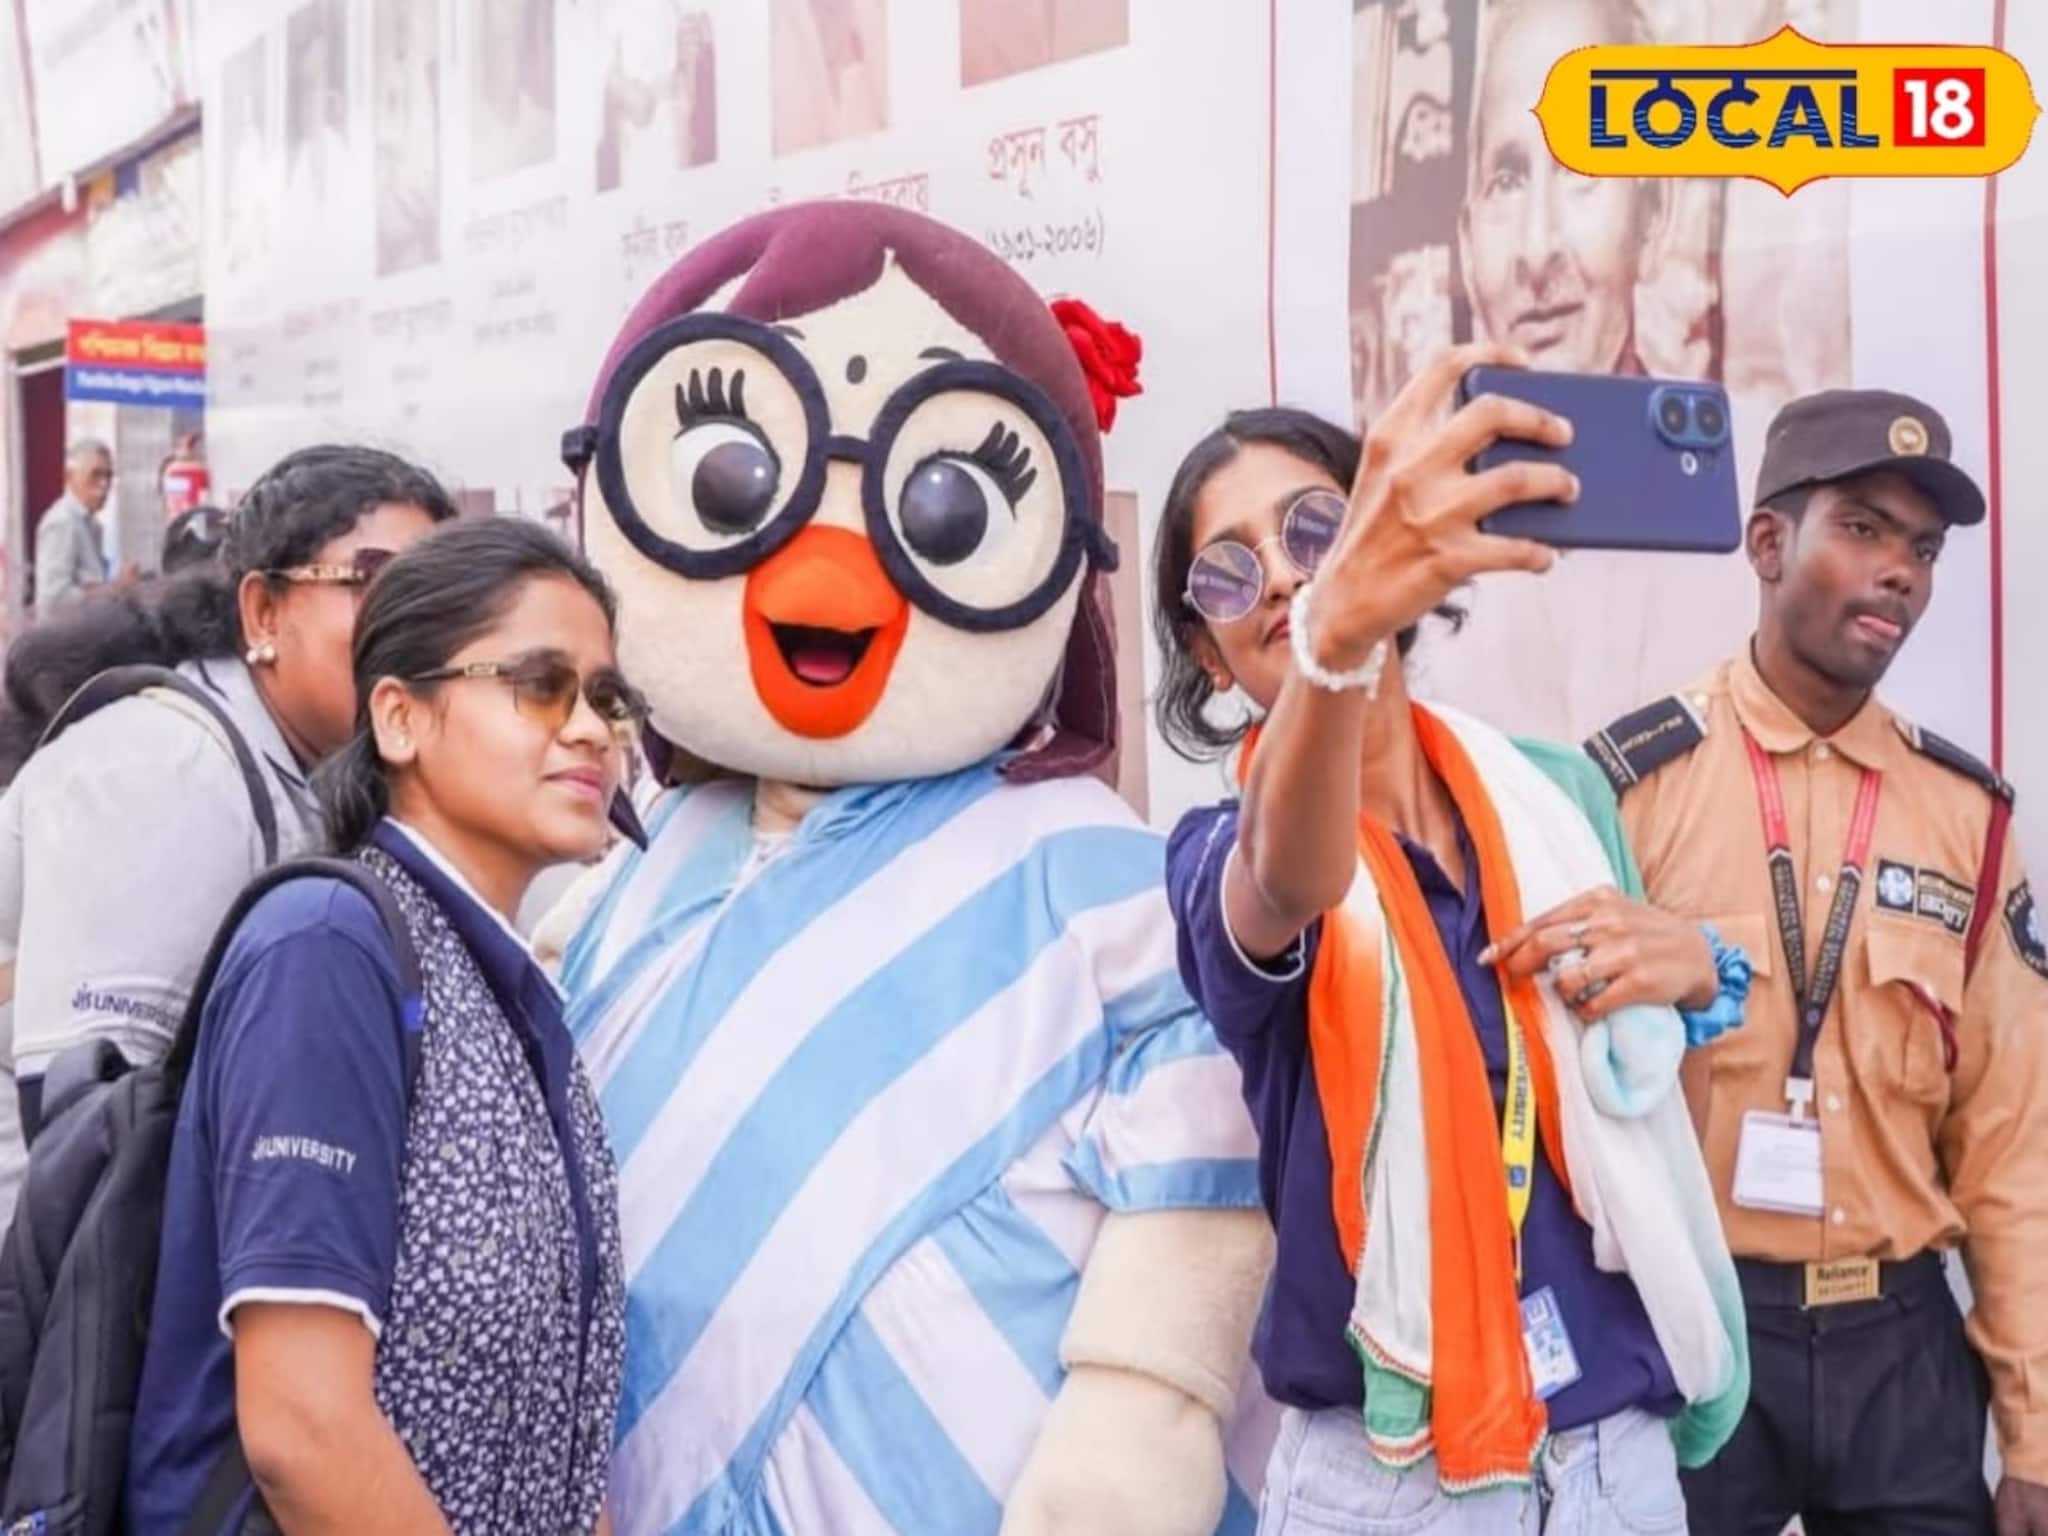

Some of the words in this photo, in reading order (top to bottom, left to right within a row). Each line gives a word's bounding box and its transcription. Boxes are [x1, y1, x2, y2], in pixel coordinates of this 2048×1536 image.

[988, 127, 1046, 200] প্রসূন
[1057, 114, 1101, 183] বসু
[263, 1136, 356, 1173] UNIVERSITY
